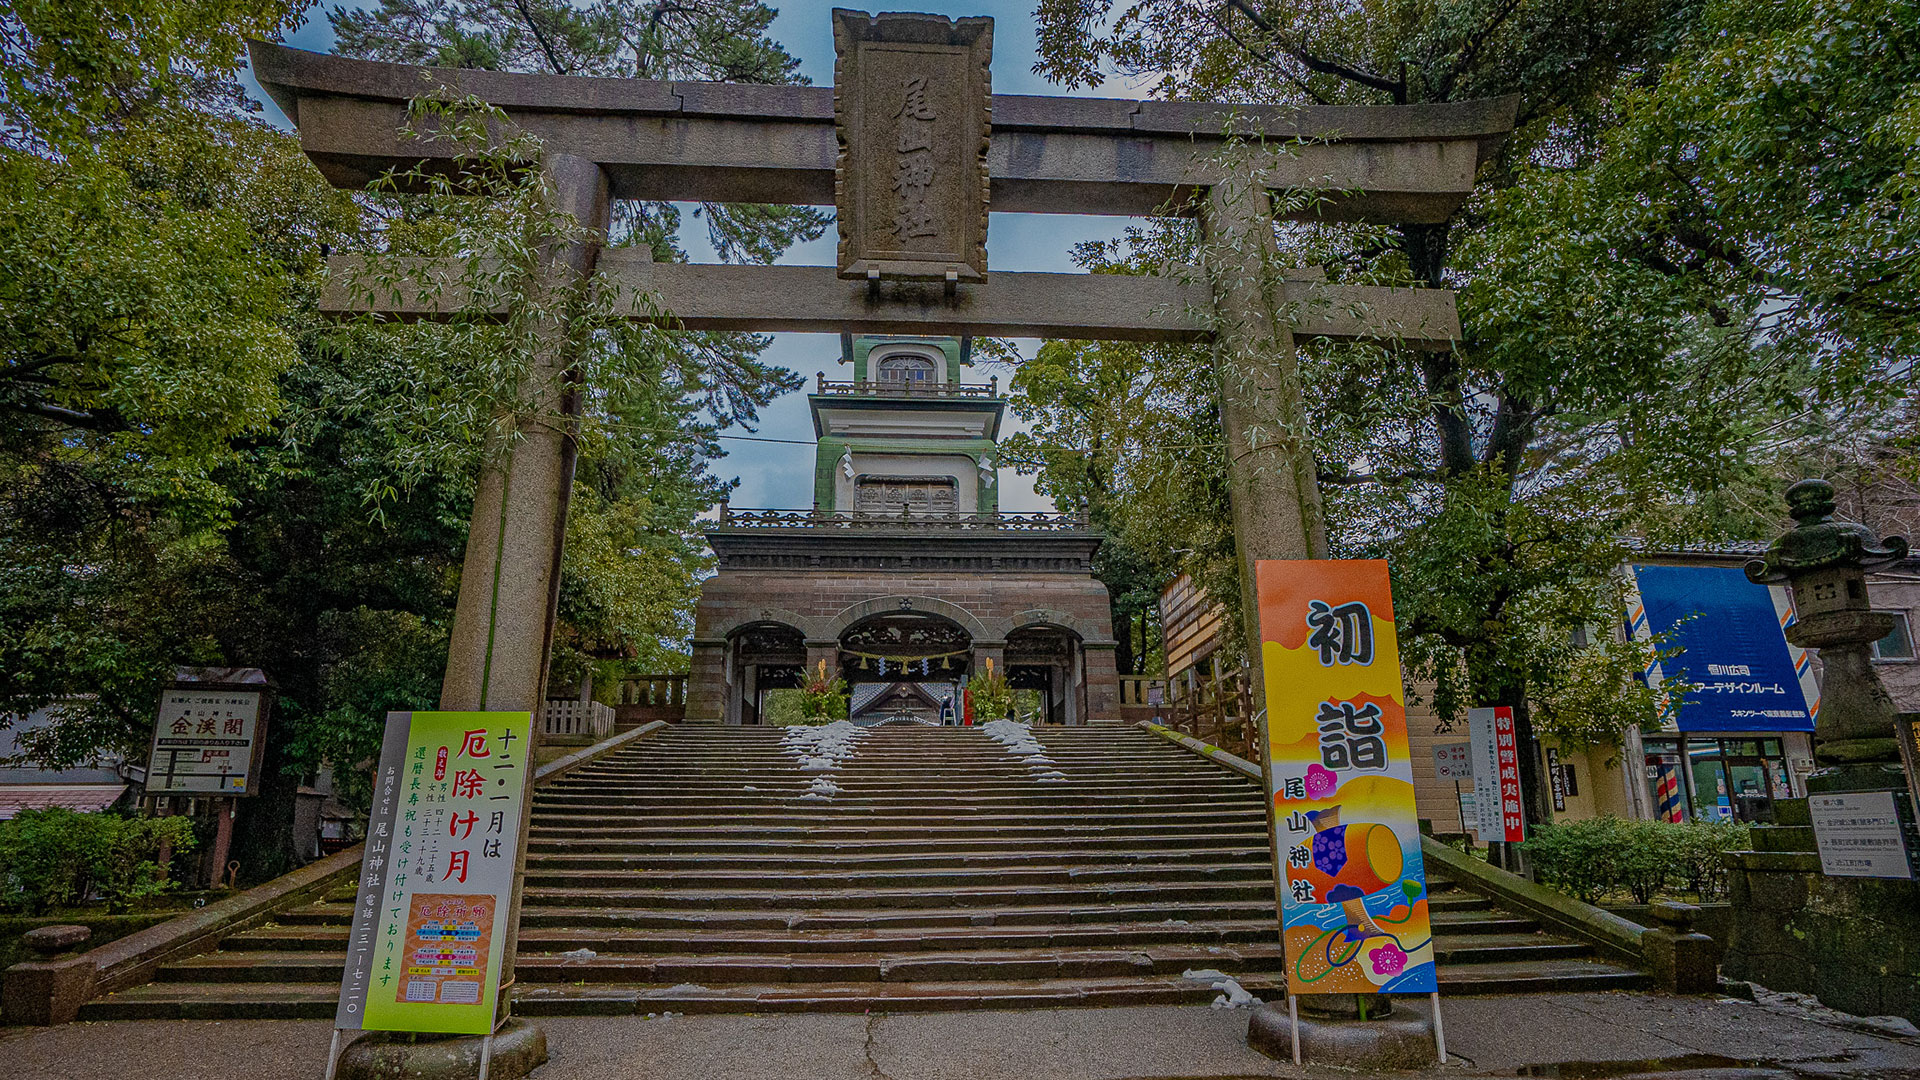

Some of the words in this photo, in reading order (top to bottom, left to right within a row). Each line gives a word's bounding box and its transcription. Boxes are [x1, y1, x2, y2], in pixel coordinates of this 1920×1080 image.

[891, 76, 937, 242] 尾山神社
[1307, 599, 1388, 771] 初詣
[1691, 682, 1786, 694] アーデザインルーム
[435, 749, 448, 779] 数え年
[441, 728, 491, 884] 厄除け月
[483, 728, 518, 858] 十二・一月は
[1496, 717, 1520, 830] 特別警戒実施中
[366, 822, 389, 888] 尾山神社
[379, 746, 427, 988] 還暦長寿祝も受け付けております
[1283, 776, 1316, 904] 尾山神社
